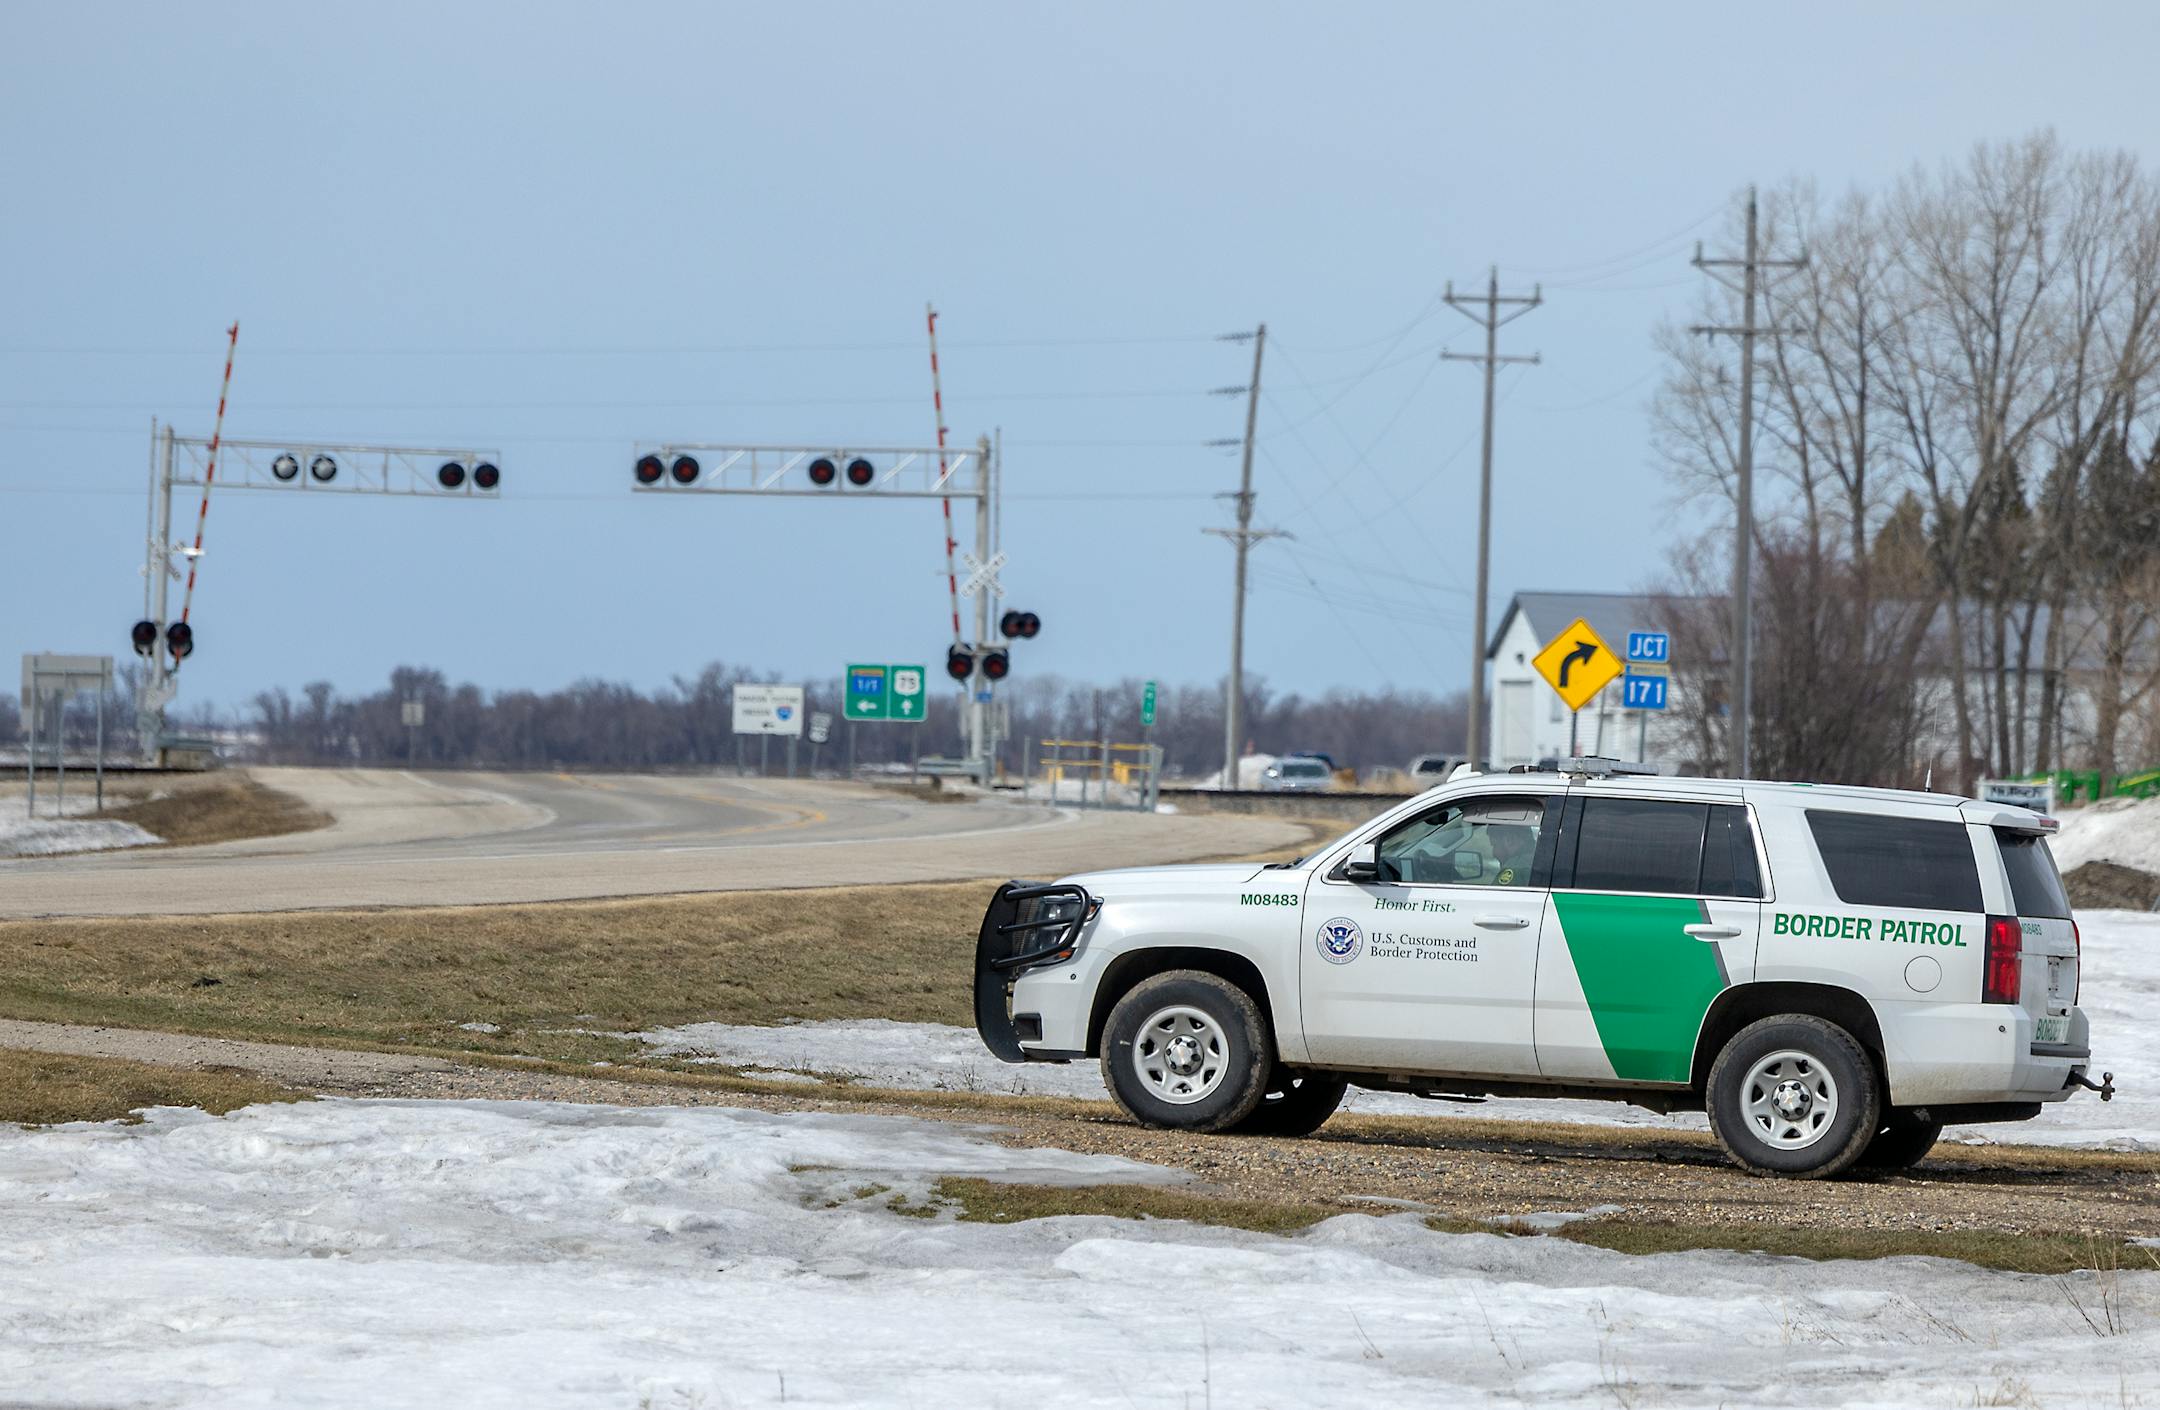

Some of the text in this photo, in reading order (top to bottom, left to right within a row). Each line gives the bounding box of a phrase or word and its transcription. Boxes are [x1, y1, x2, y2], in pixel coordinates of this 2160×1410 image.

[1630, 637, 1665, 657] JCT
[1629, 681, 1662, 704] 171
[1241, 894, 1298, 906] M08483
[1374, 898, 1418, 911] Honor
[1774, 913, 1967, 947] BORDER PATROL
[1372, 932, 1476, 948] U.S. Customs and
[1370, 946, 1478, 962] Border Protection
